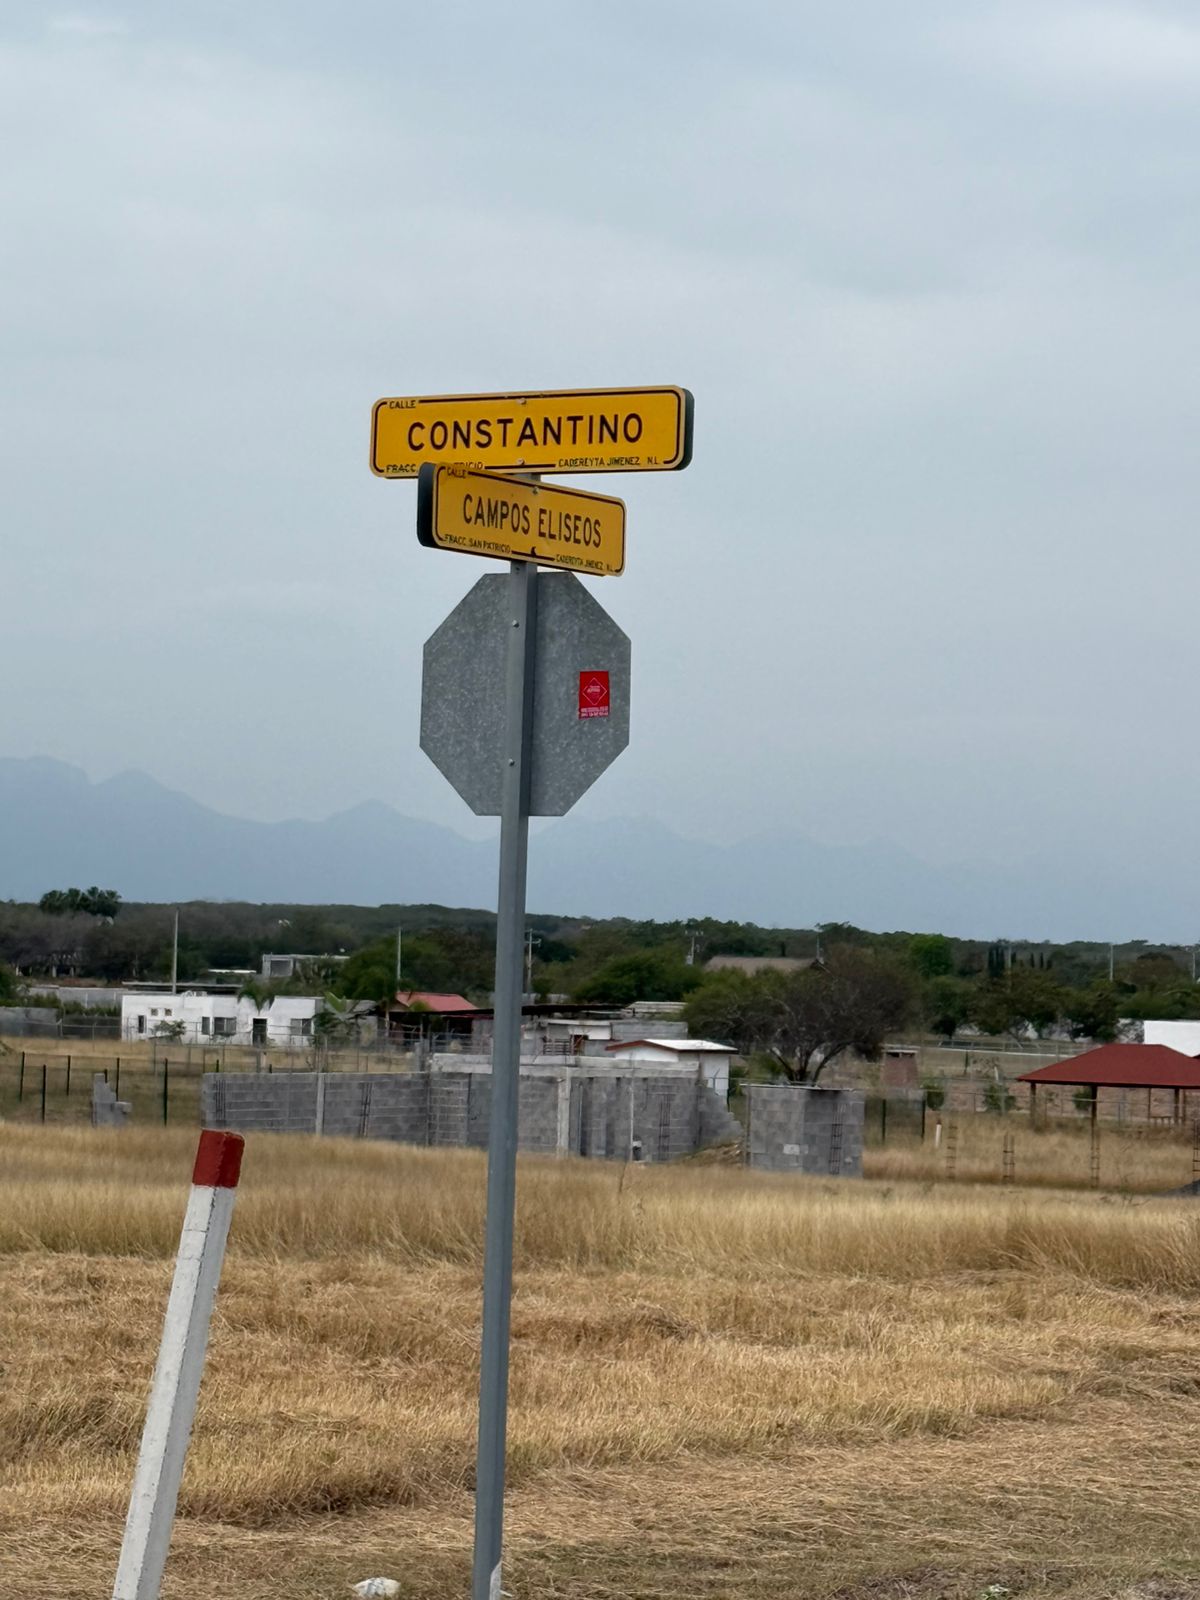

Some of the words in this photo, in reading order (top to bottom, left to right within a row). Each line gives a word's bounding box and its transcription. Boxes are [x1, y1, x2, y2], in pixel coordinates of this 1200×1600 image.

[389, 400, 416, 409] CALLE
[408, 413, 643, 451] CONSTANTINO
[558, 457, 605, 468] CADEREYTA
[606, 456, 640, 466] JIMENEZ
[446, 467, 467, 479] CALLE
[463, 493, 530, 535] CAMPOS
[538, 508, 602, 548] ELISEOS
[469, 538, 482, 550] SAN
[483, 540, 511, 554] PATRICIO
